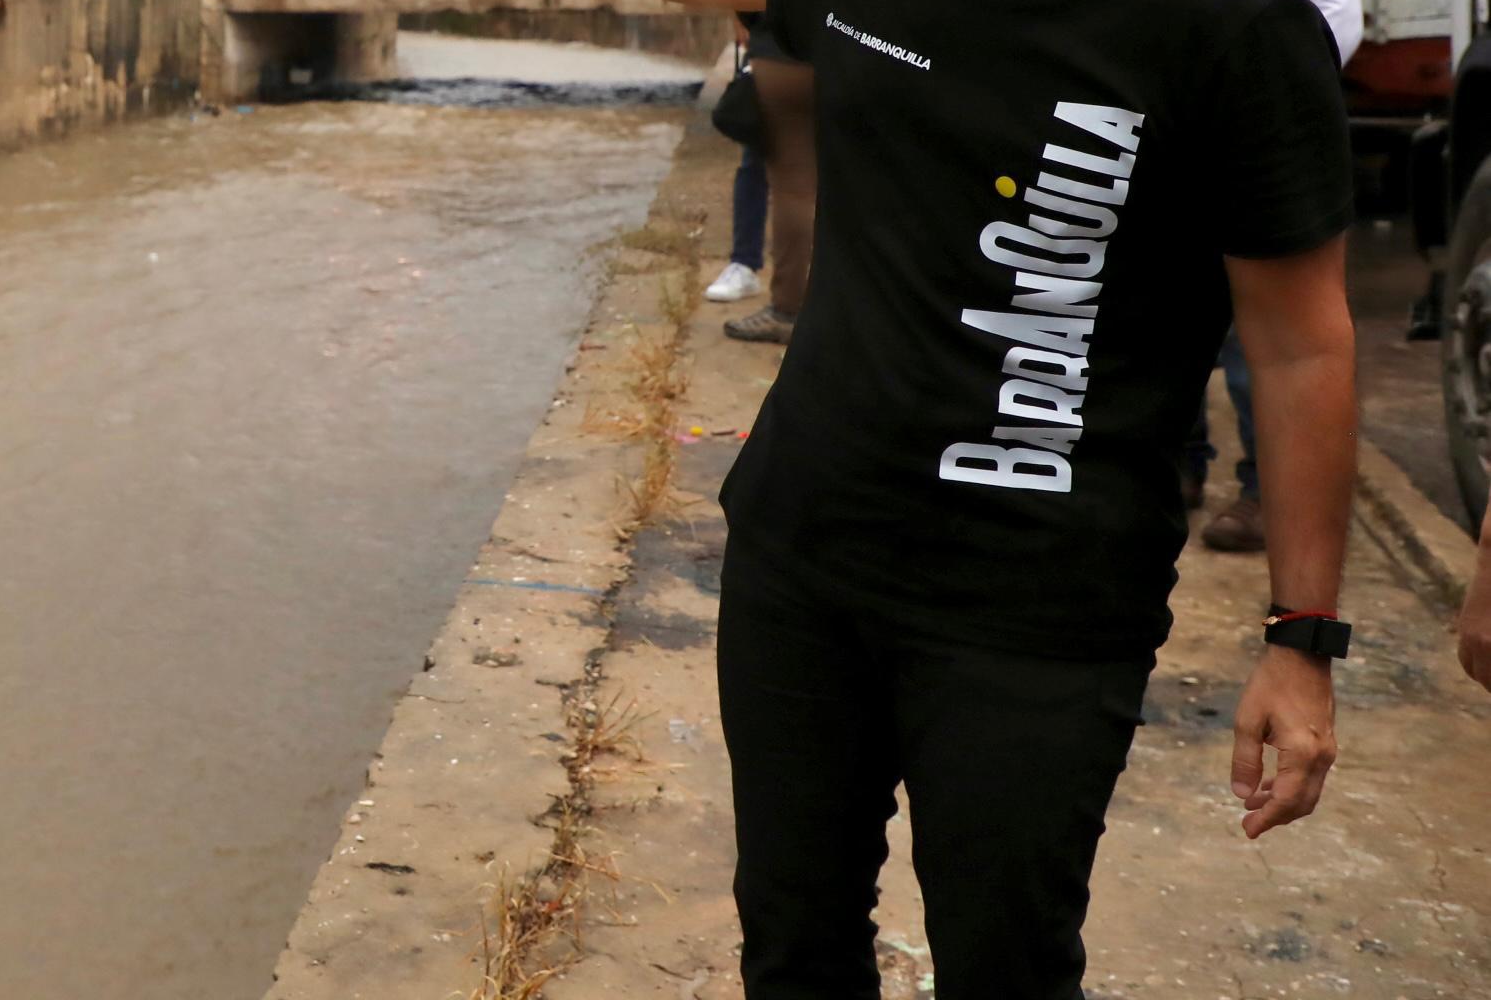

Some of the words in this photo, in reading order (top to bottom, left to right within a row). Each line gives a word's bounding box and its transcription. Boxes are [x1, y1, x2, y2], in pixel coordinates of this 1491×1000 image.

[832, 19, 854, 36] ALCALDÍA
[860, 33, 931, 70] BARRANQUILLA
[939, 101, 1145, 492] BARRANQUILLA
